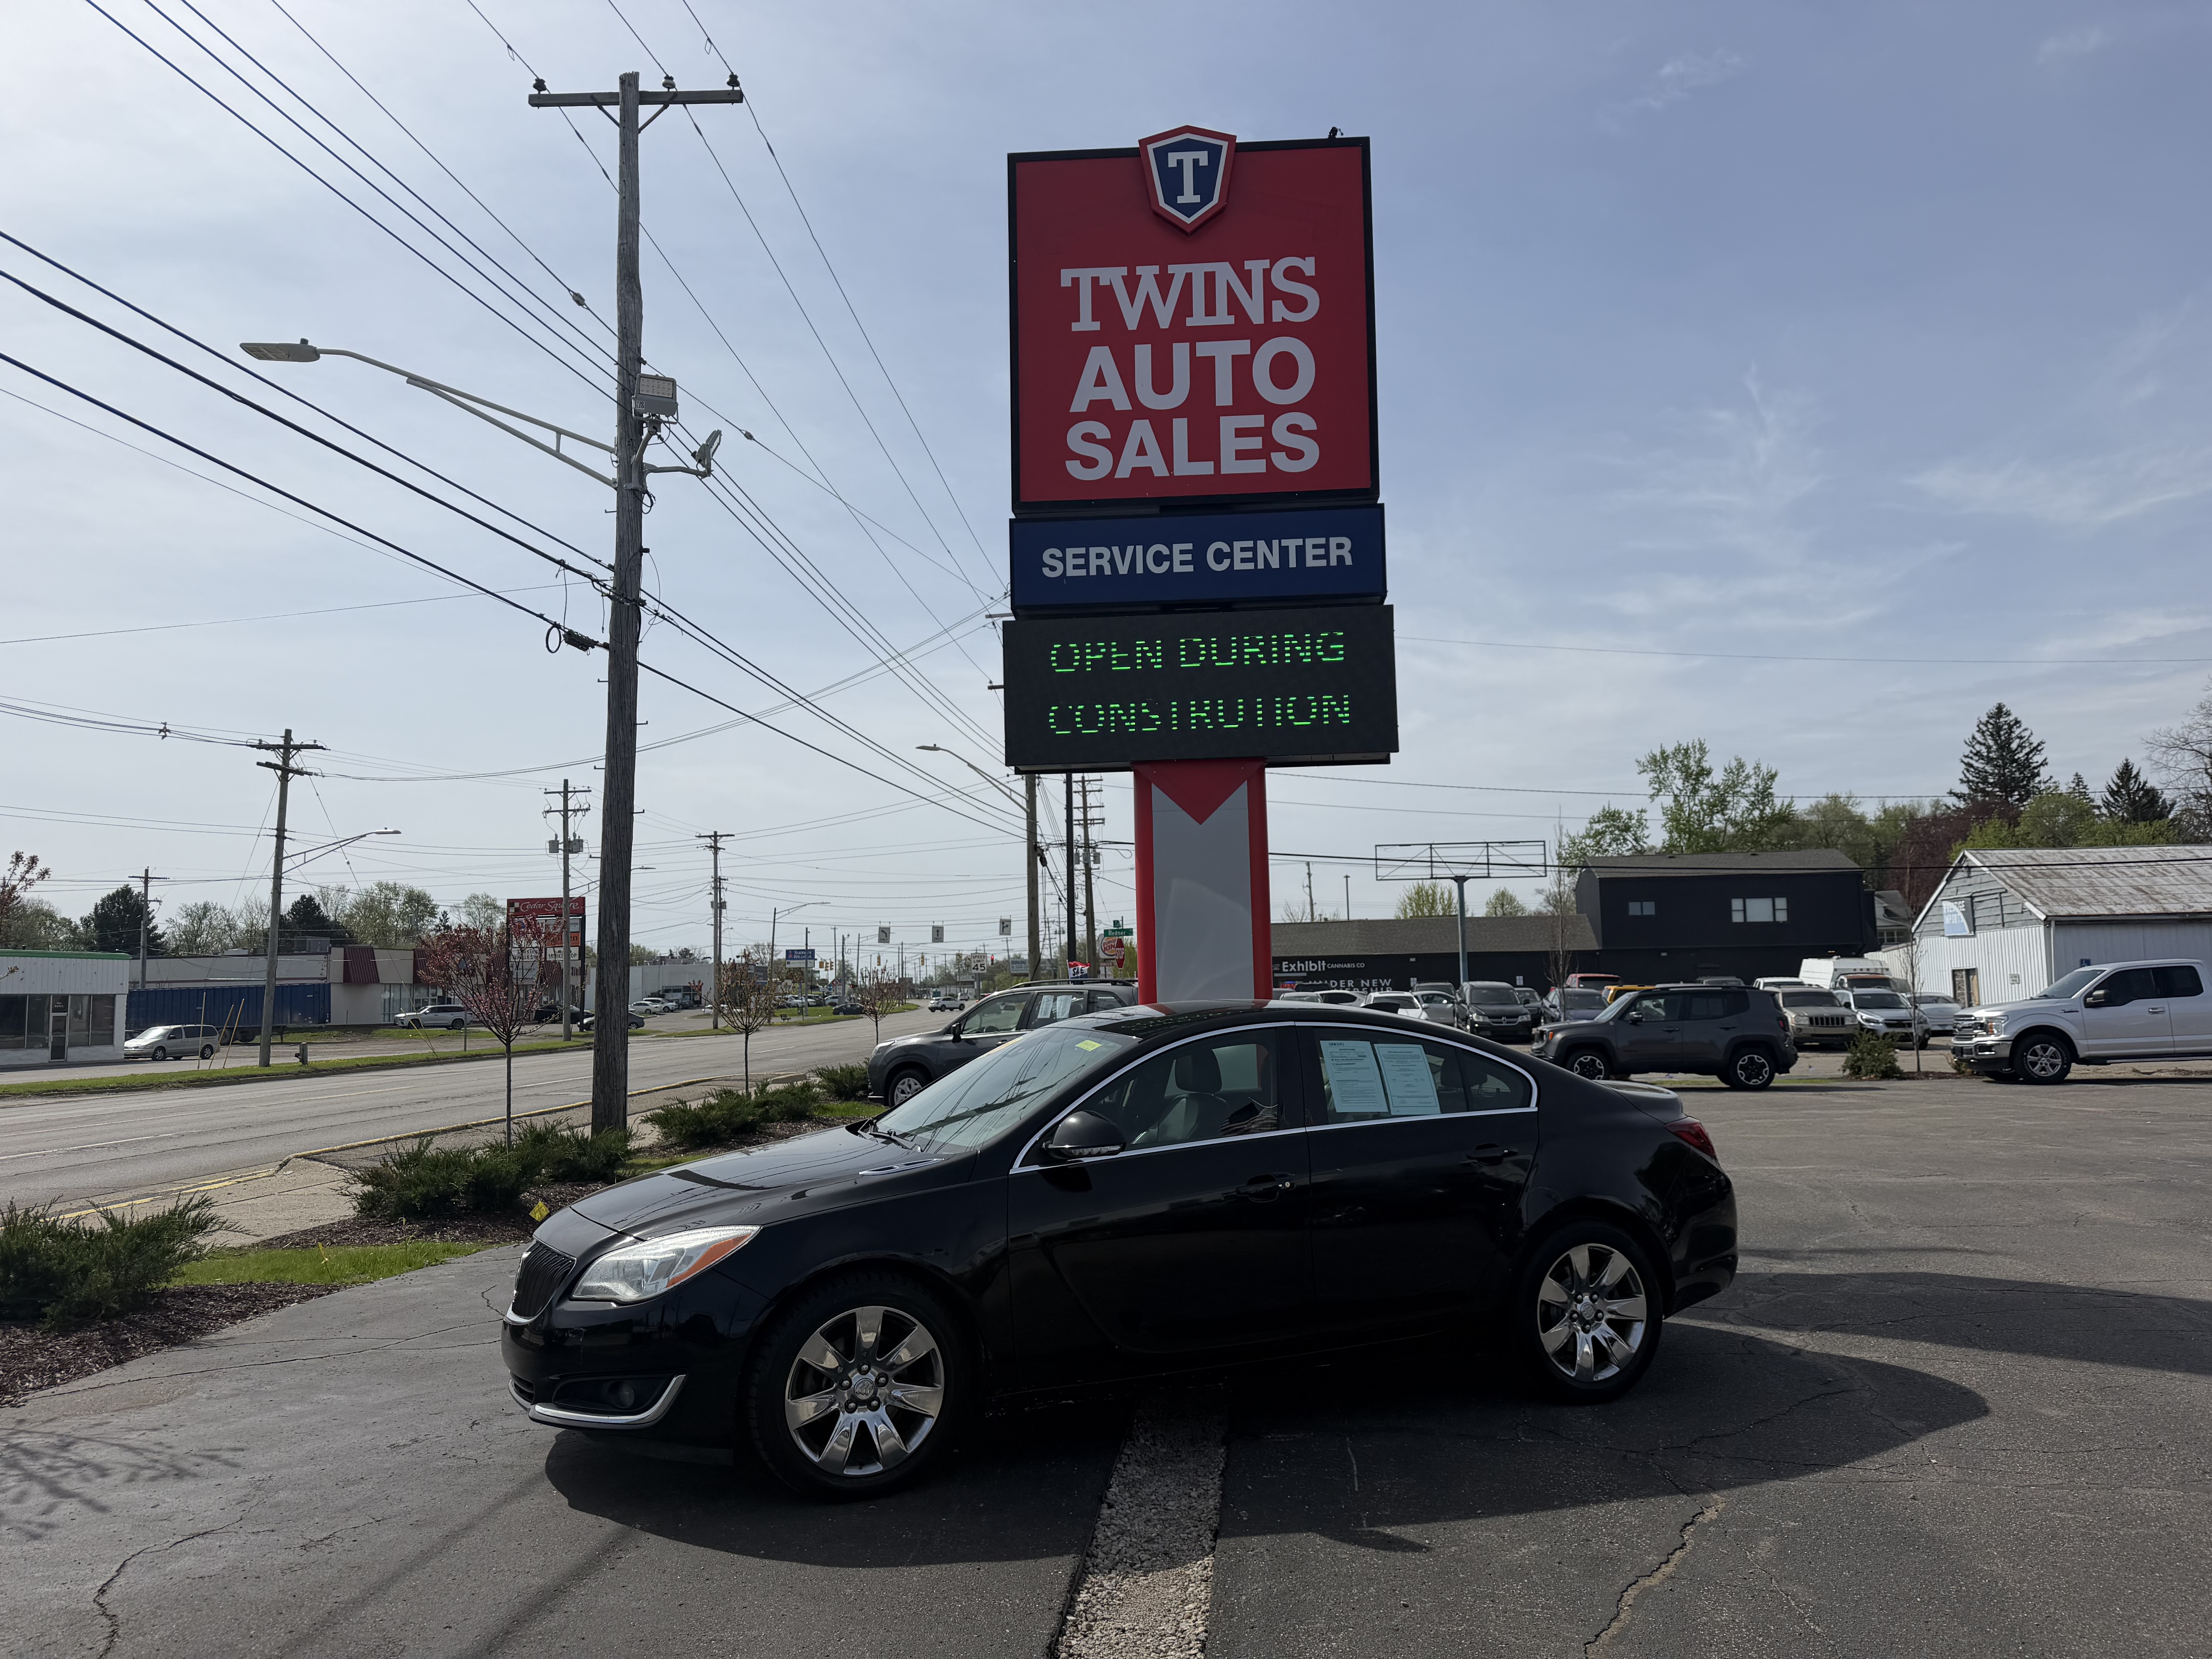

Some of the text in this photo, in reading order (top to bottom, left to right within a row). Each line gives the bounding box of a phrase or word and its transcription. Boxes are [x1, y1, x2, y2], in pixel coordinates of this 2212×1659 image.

[1168, 151, 1208, 204] T
[1060, 256, 1320, 332] TWINS
[1069, 336, 1316, 412] AUTO
[1065, 412, 1320, 481] SALES
[1042, 536, 1353, 577] SERVICE CENTER
[1051, 632, 1345, 672] OPEN DURING
[520, 901, 579, 912] Cedar Squre
[1103, 943, 1116, 952] KIN
[1116, 948, 1124, 959] STOP
[1361, 979, 1392, 987] NEW
